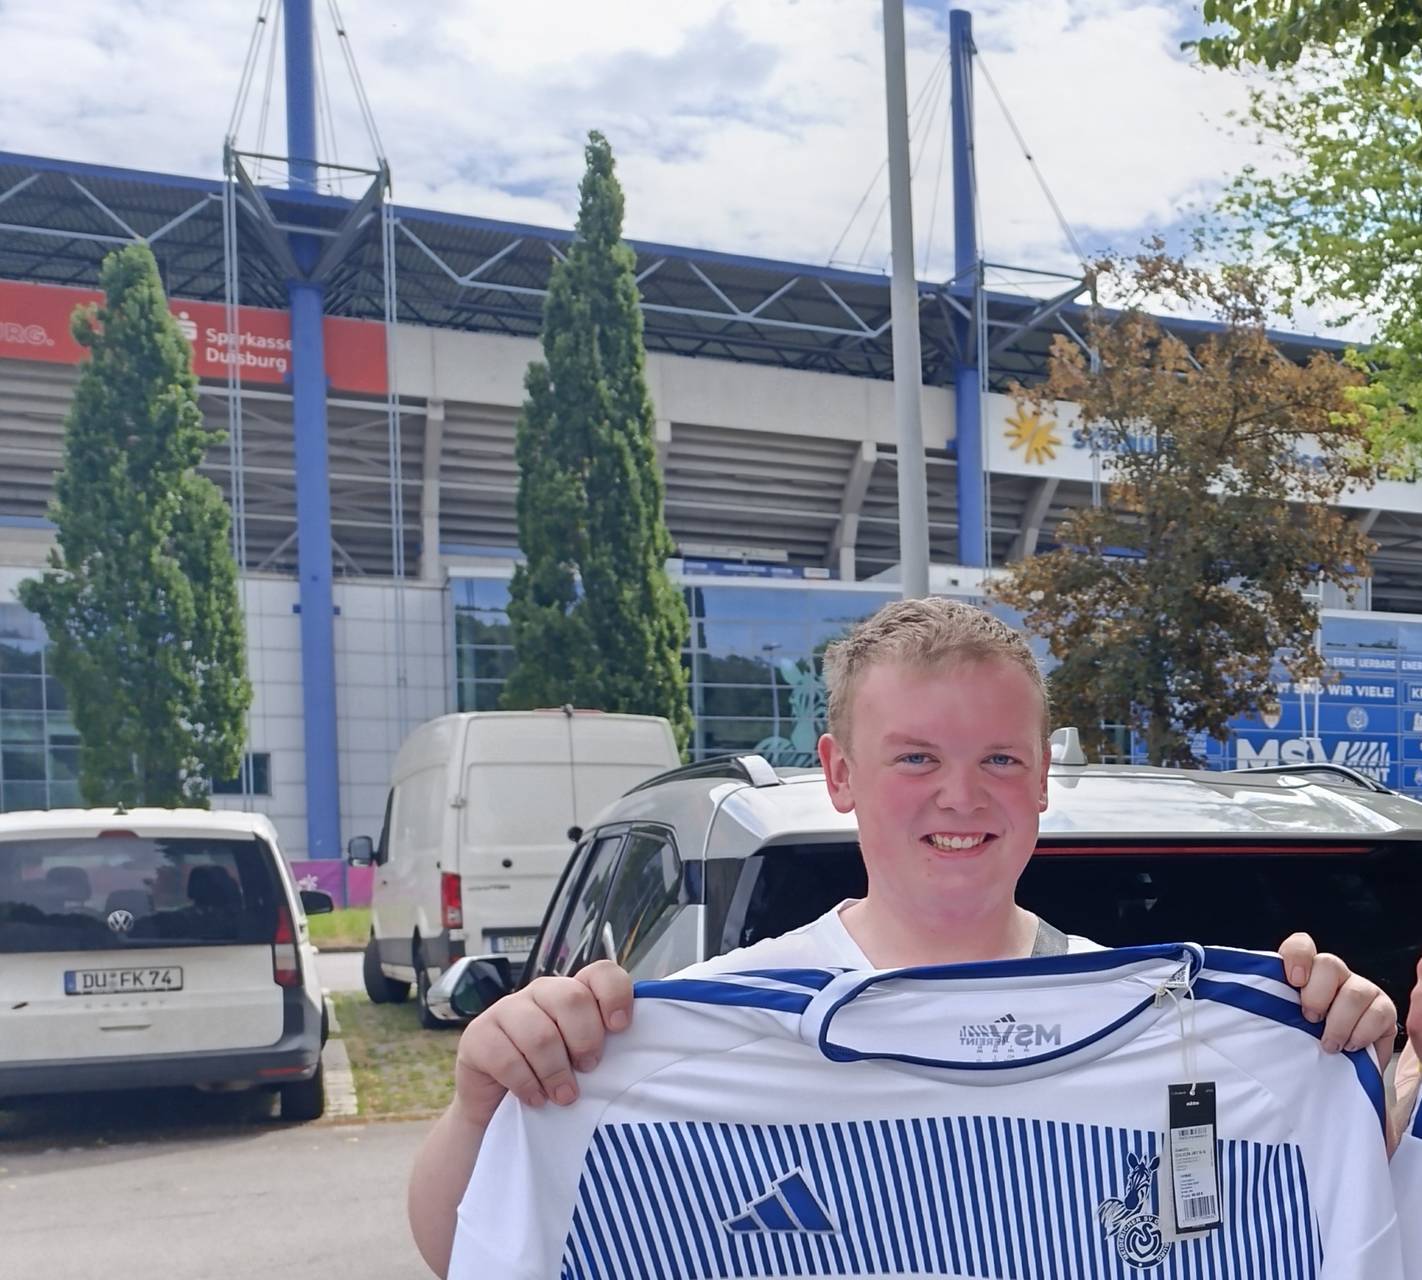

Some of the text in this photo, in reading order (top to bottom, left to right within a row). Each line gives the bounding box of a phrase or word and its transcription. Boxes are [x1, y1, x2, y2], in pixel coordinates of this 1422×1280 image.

[206, 347, 287, 373] Duisburg
[1327, 684, 1353, 696] WIR
[1355, 685, 1395, 698] VIELE!
[83, 969, 172, 988] DU FK 74
